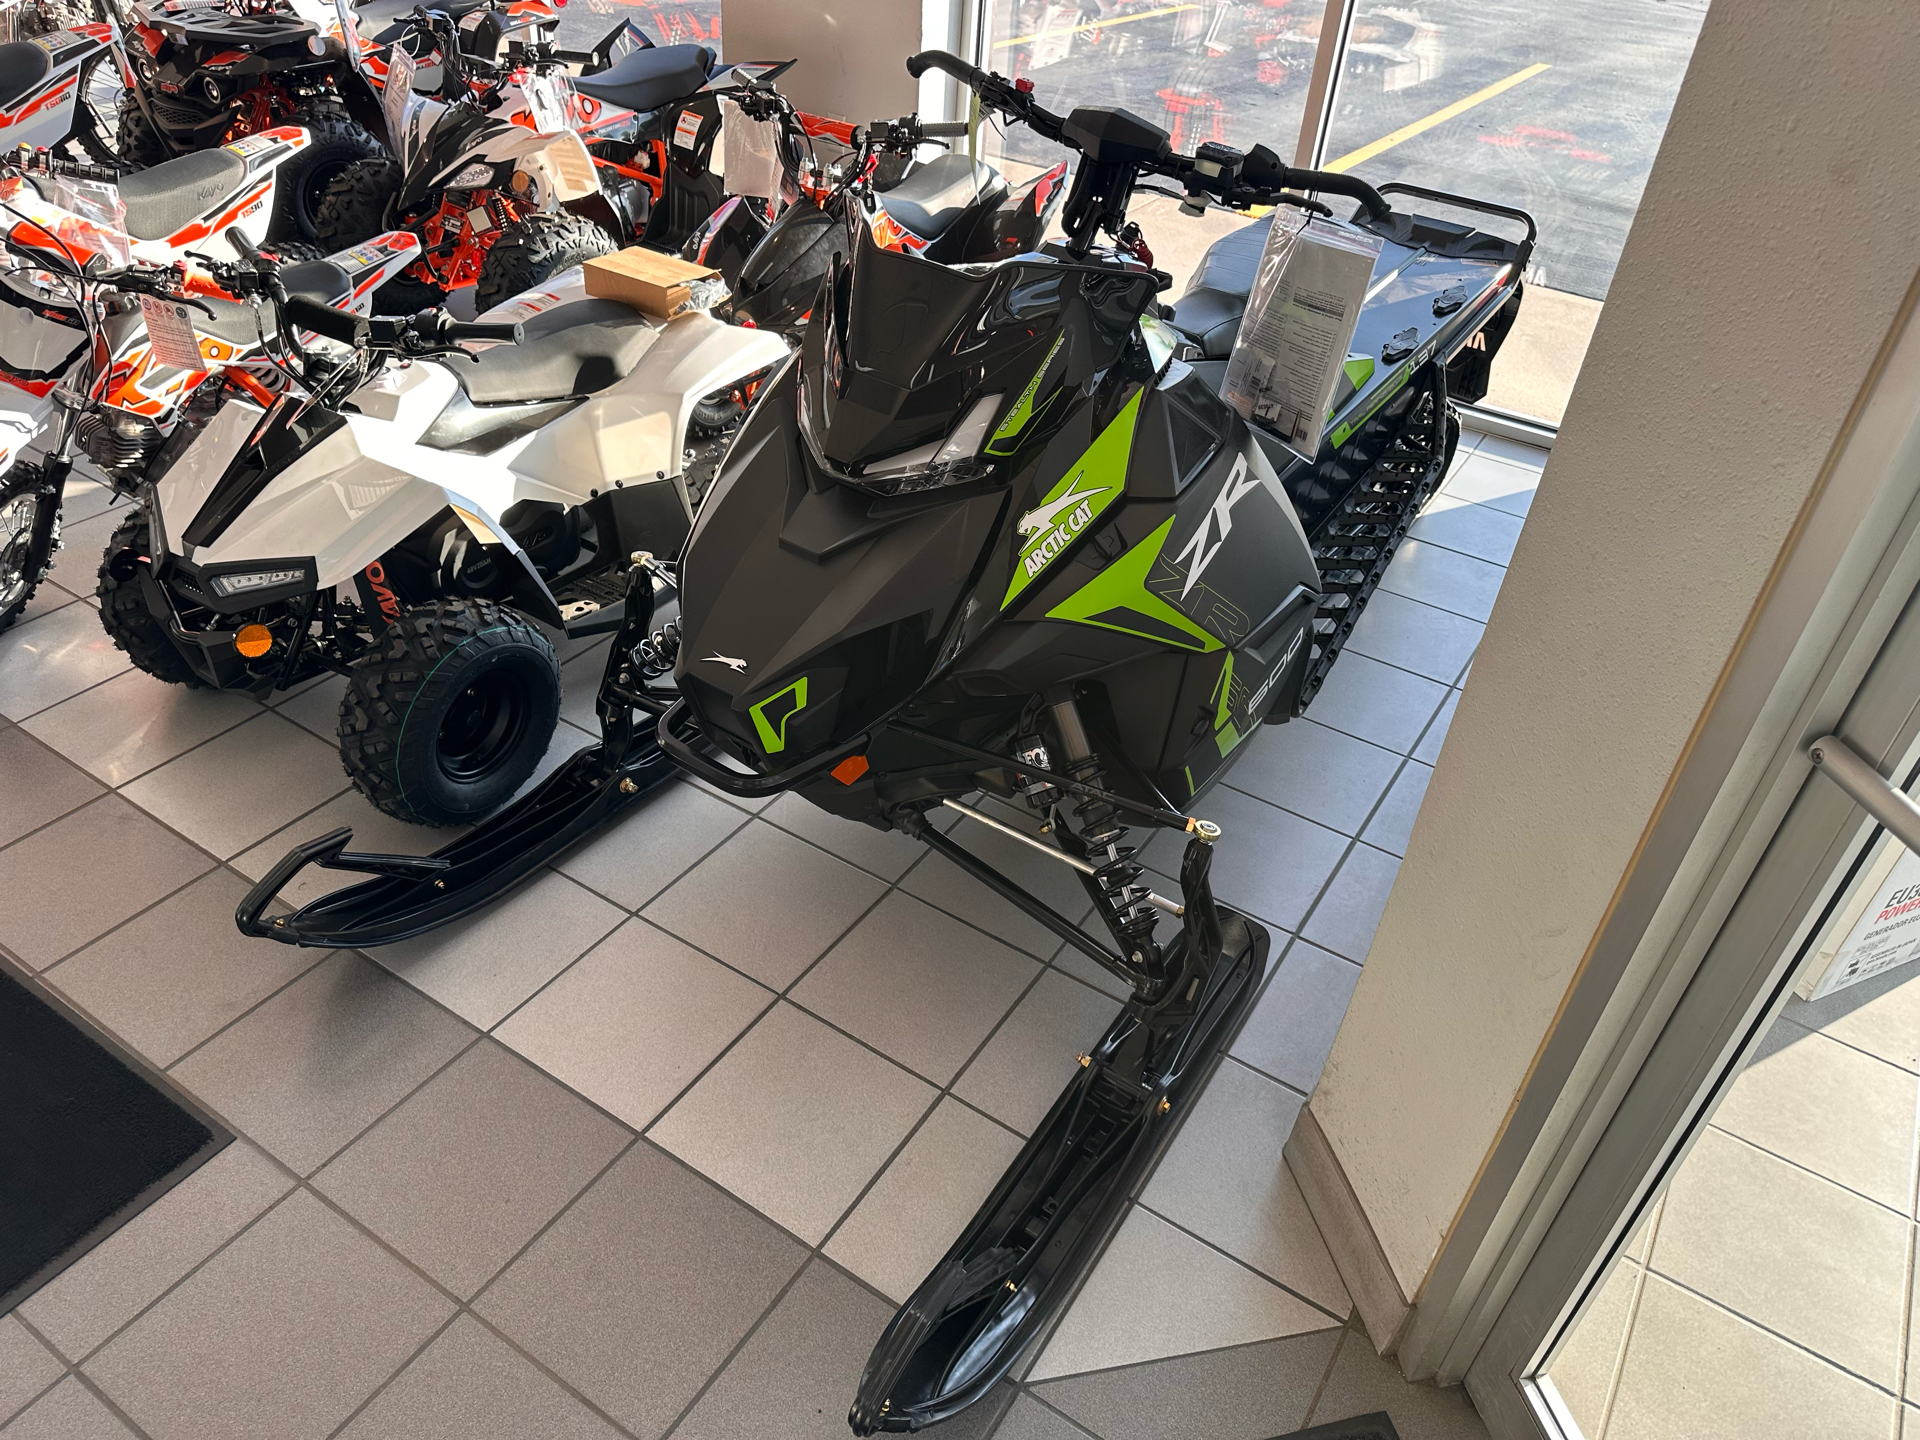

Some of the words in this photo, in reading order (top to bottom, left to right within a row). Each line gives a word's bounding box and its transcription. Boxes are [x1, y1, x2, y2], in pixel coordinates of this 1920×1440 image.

[241, 200, 264, 219] TS90
[1000, 381, 1038, 432] STEALTH
[1037, 337, 1065, 379] SERIES
[1410, 340, 1437, 375] 137
[1024, 522, 1071, 579] ARCTIC
[1067, 497, 1093, 532] CAT
[1173, 452, 1261, 602] ZR
[1248, 626, 1304, 714] 600
